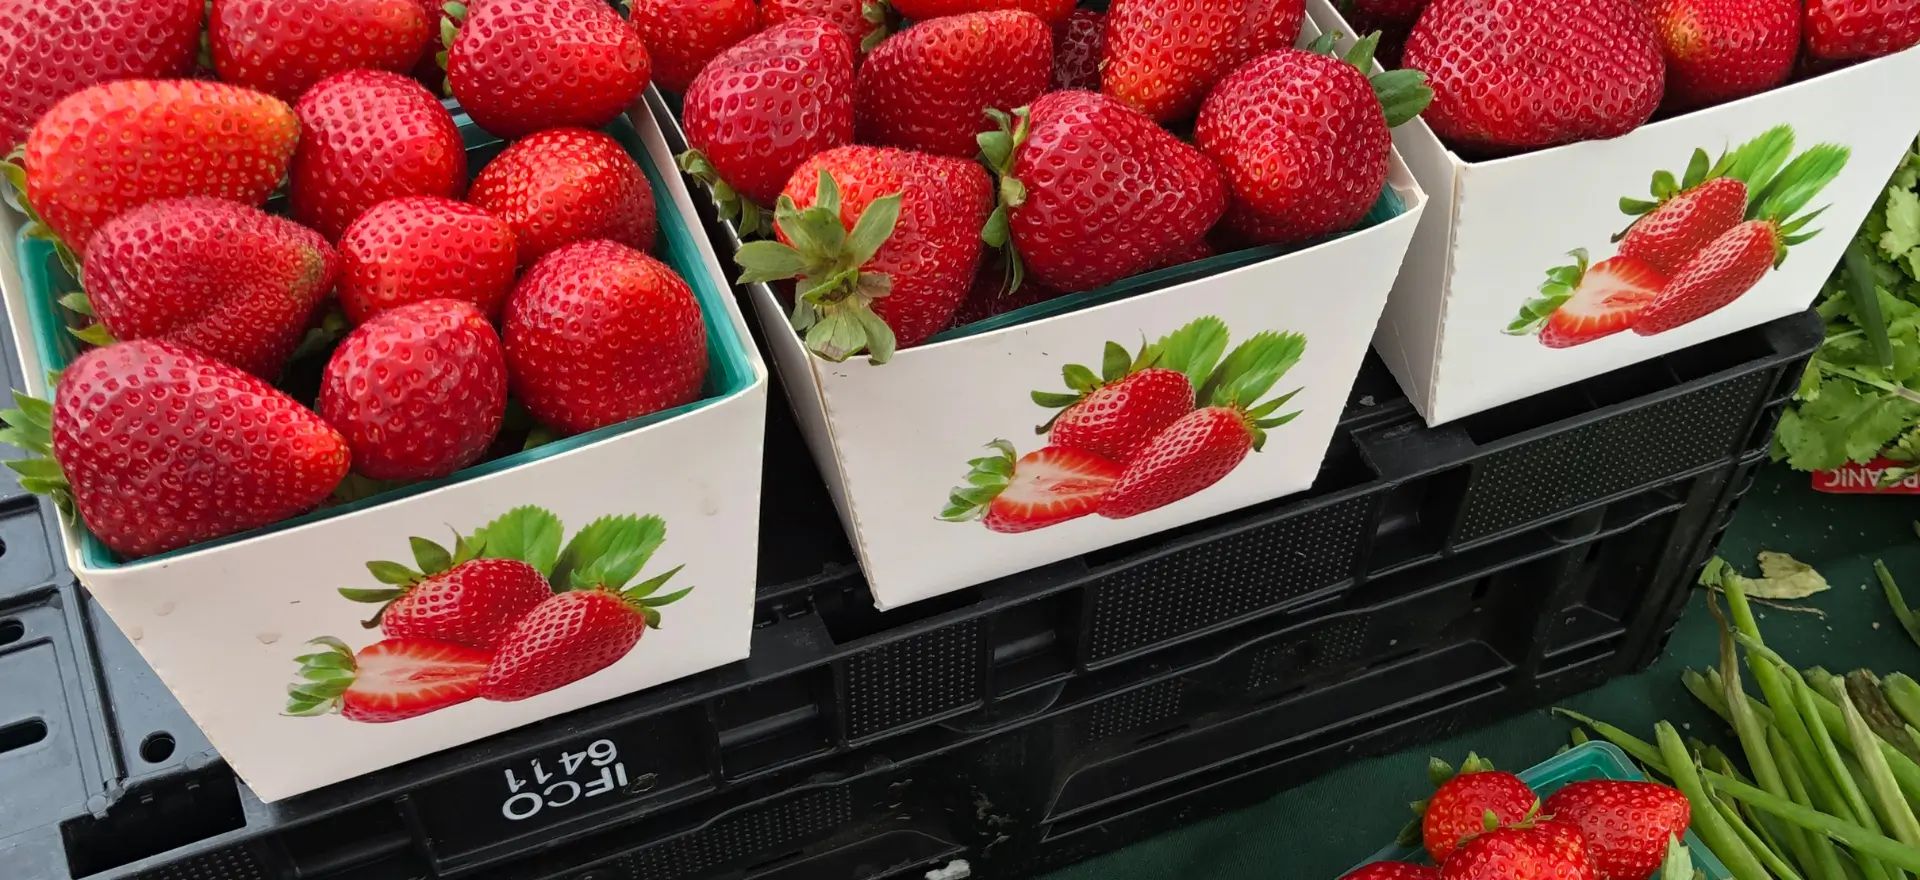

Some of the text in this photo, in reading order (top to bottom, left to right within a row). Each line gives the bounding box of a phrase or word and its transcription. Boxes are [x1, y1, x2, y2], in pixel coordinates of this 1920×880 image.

[1823, 466, 1920, 488] RANIC
[502, 762, 628, 820] IFCO
[504, 739, 617, 793] 6411
